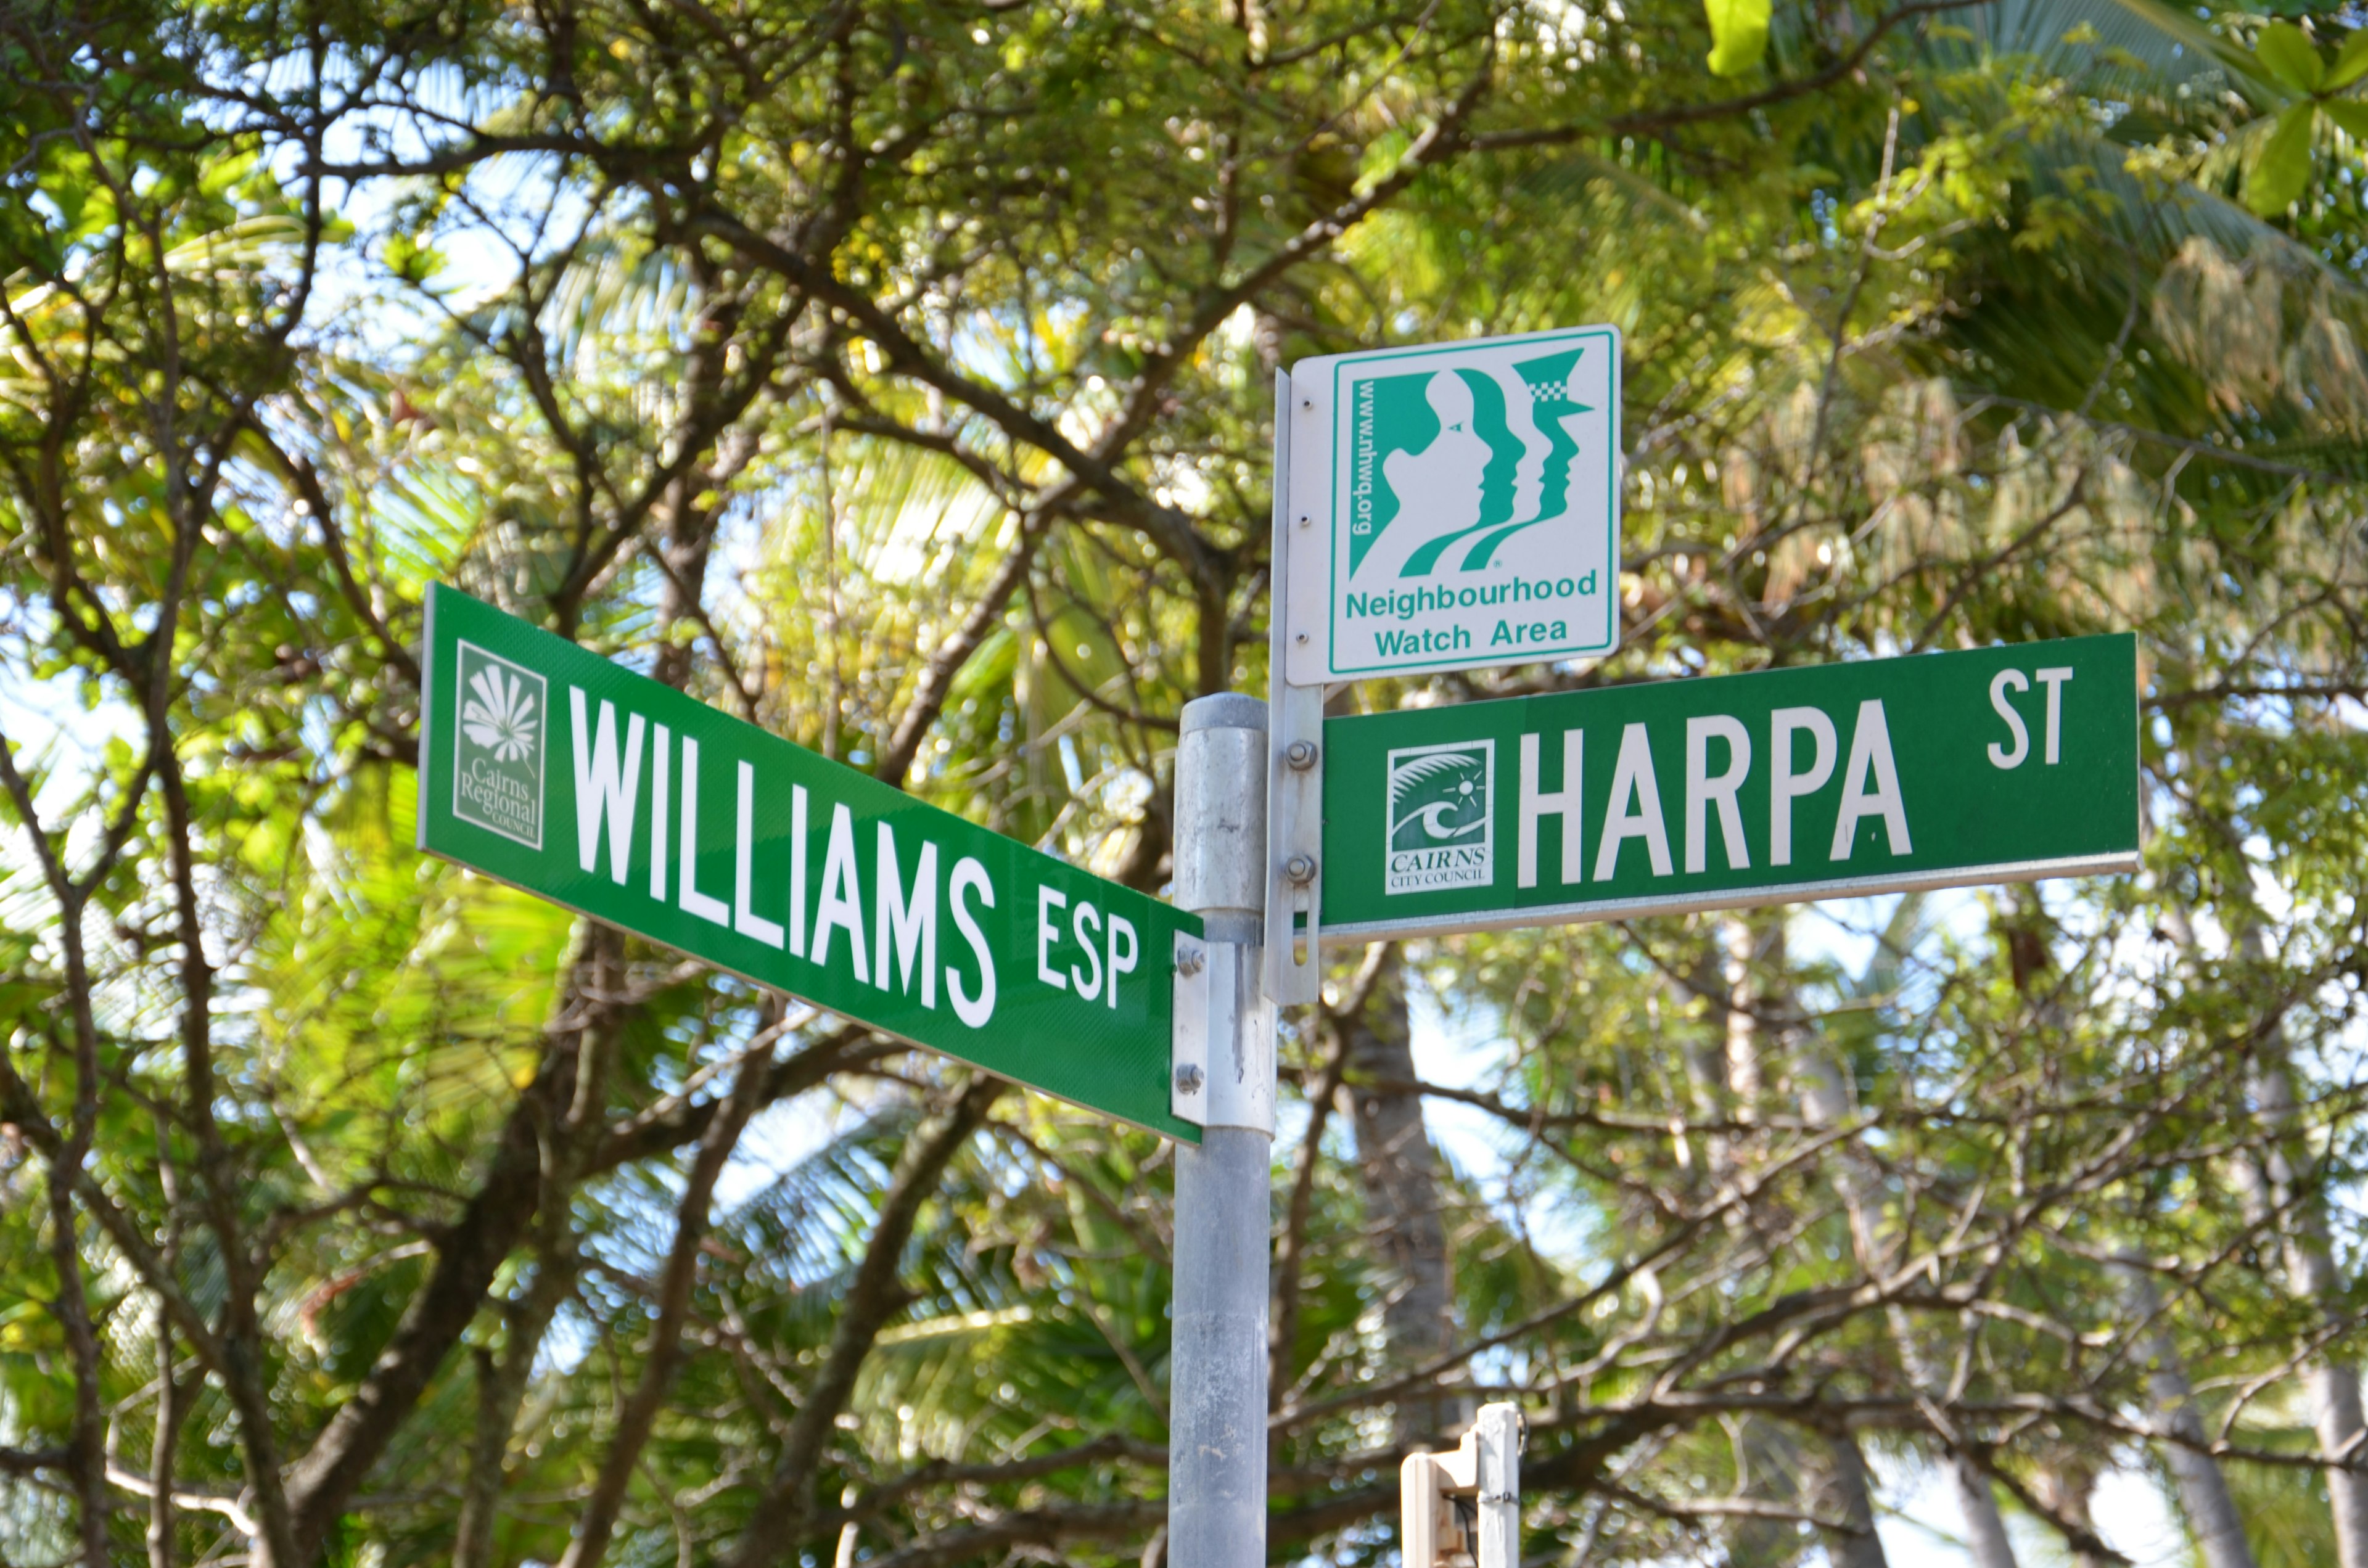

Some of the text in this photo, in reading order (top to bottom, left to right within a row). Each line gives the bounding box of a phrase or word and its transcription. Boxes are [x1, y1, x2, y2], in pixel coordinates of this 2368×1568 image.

[1352, 380, 1377, 535] www.nhwq.org
[1347, 569, 1597, 620] Neighbourhood
[1375, 620, 1567, 656] Watch Area
[461, 772, 535, 824] Regional
[472, 757, 528, 801] Cairns
[1518, 667, 2073, 889] HARPA ST
[492, 812, 535, 839] COUNCIL
[569, 684, 1138, 1028] WILLIAMS ESP
[1391, 847, 1485, 873] CAIRNS
[1391, 869, 1484, 888] CITY COUNCIL
